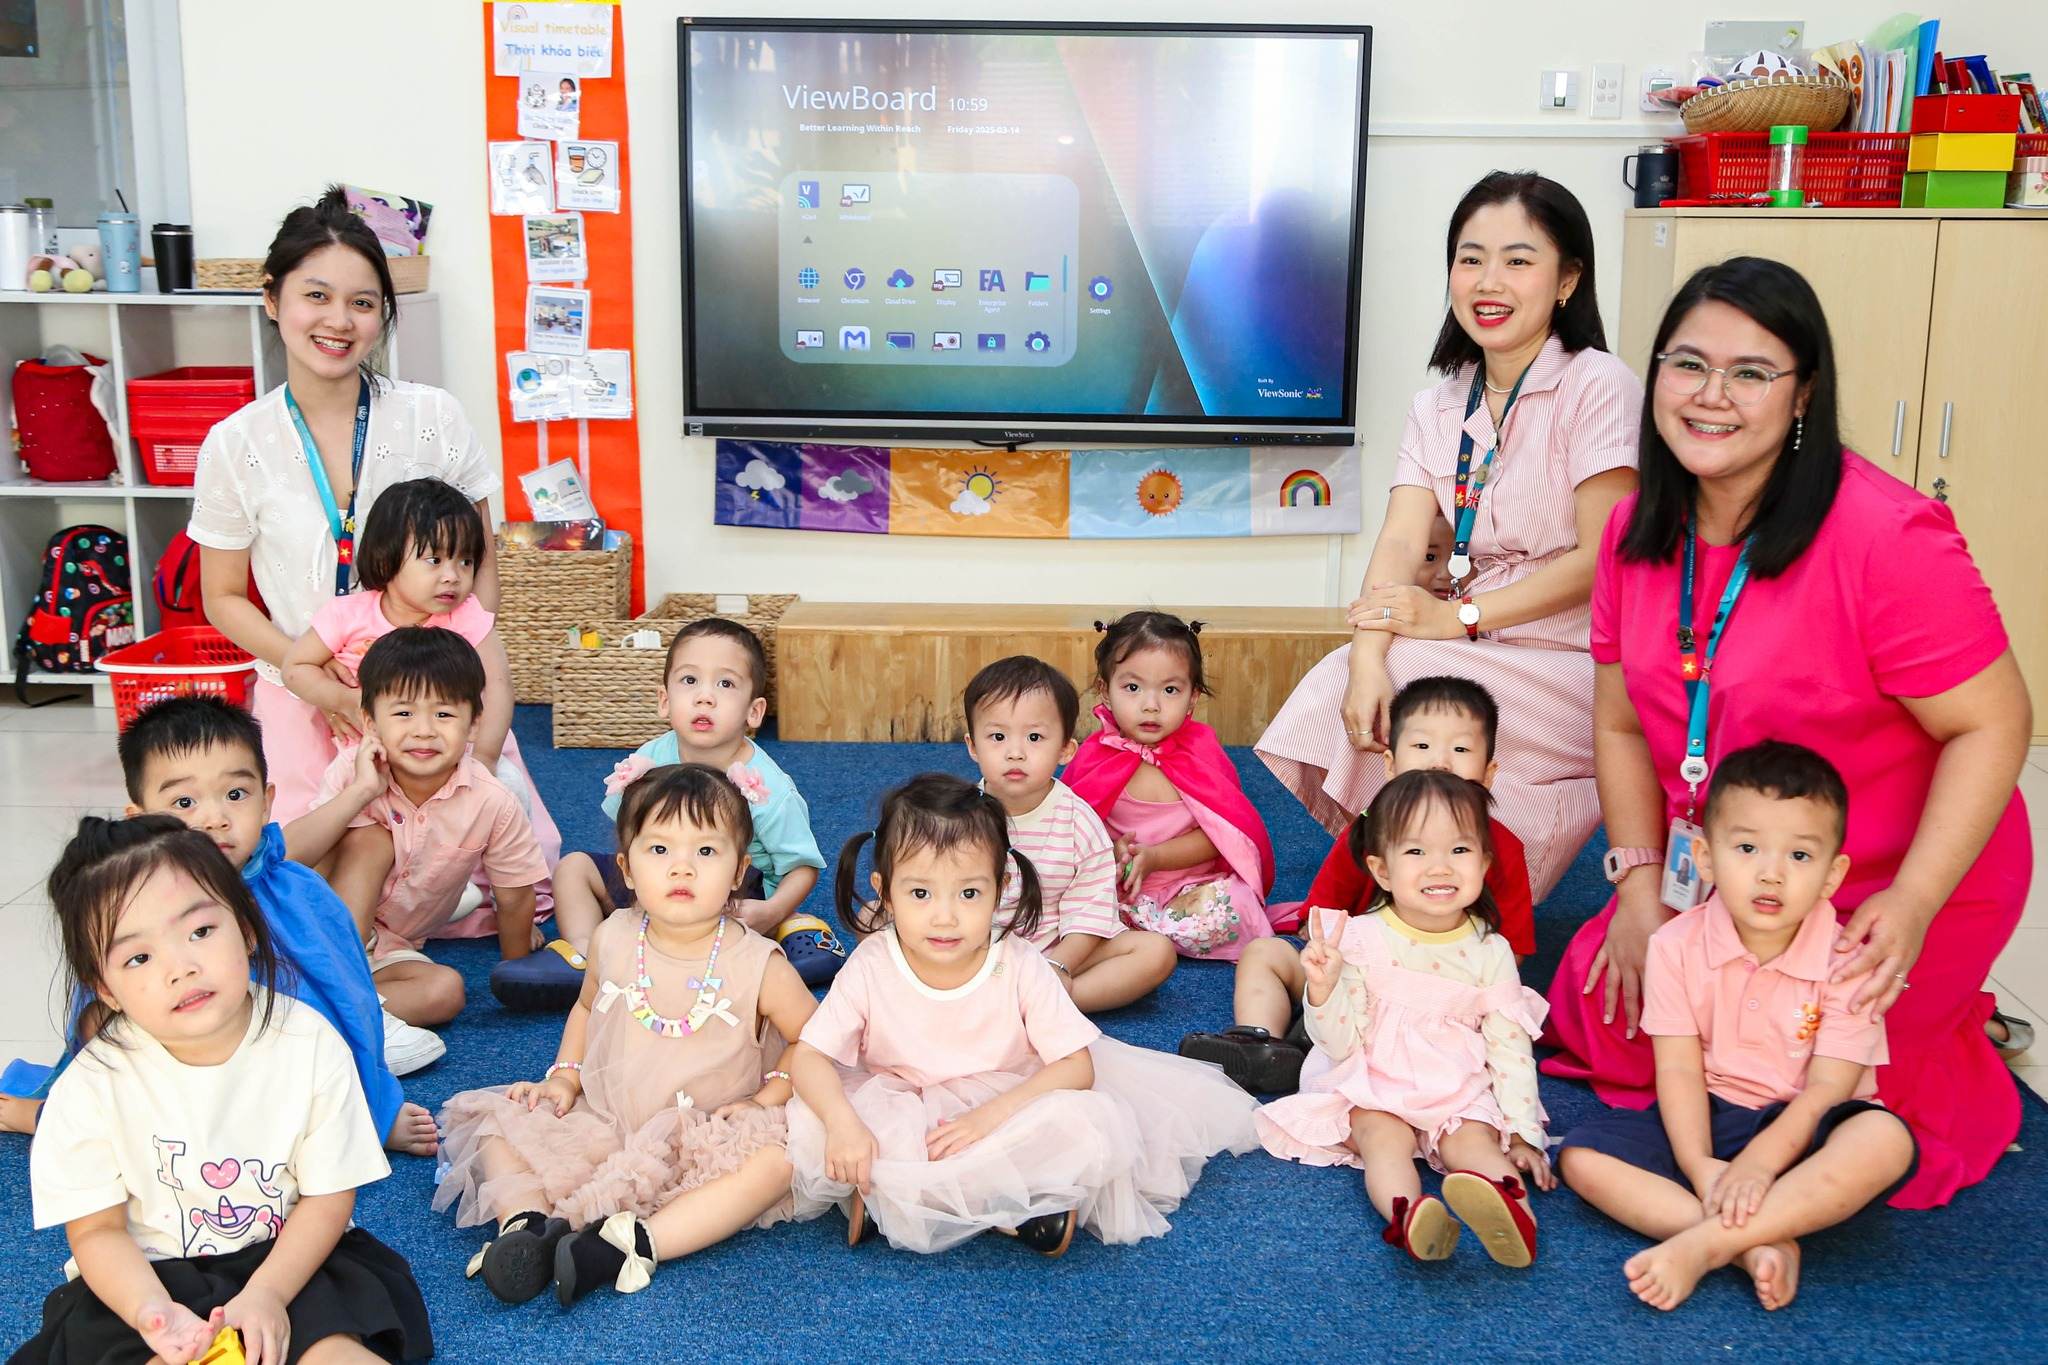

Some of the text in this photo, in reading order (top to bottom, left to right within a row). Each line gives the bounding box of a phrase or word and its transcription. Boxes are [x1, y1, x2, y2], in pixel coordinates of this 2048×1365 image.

[500, 21, 607, 35] Visual timetable
[782, 85, 988, 111] ViewBoard 10:59
[799, 123, 921, 135] Better Learning Within Reach
[947, 125, 973, 136] Friday
[1258, 388, 1302, 398] ViewSonic
